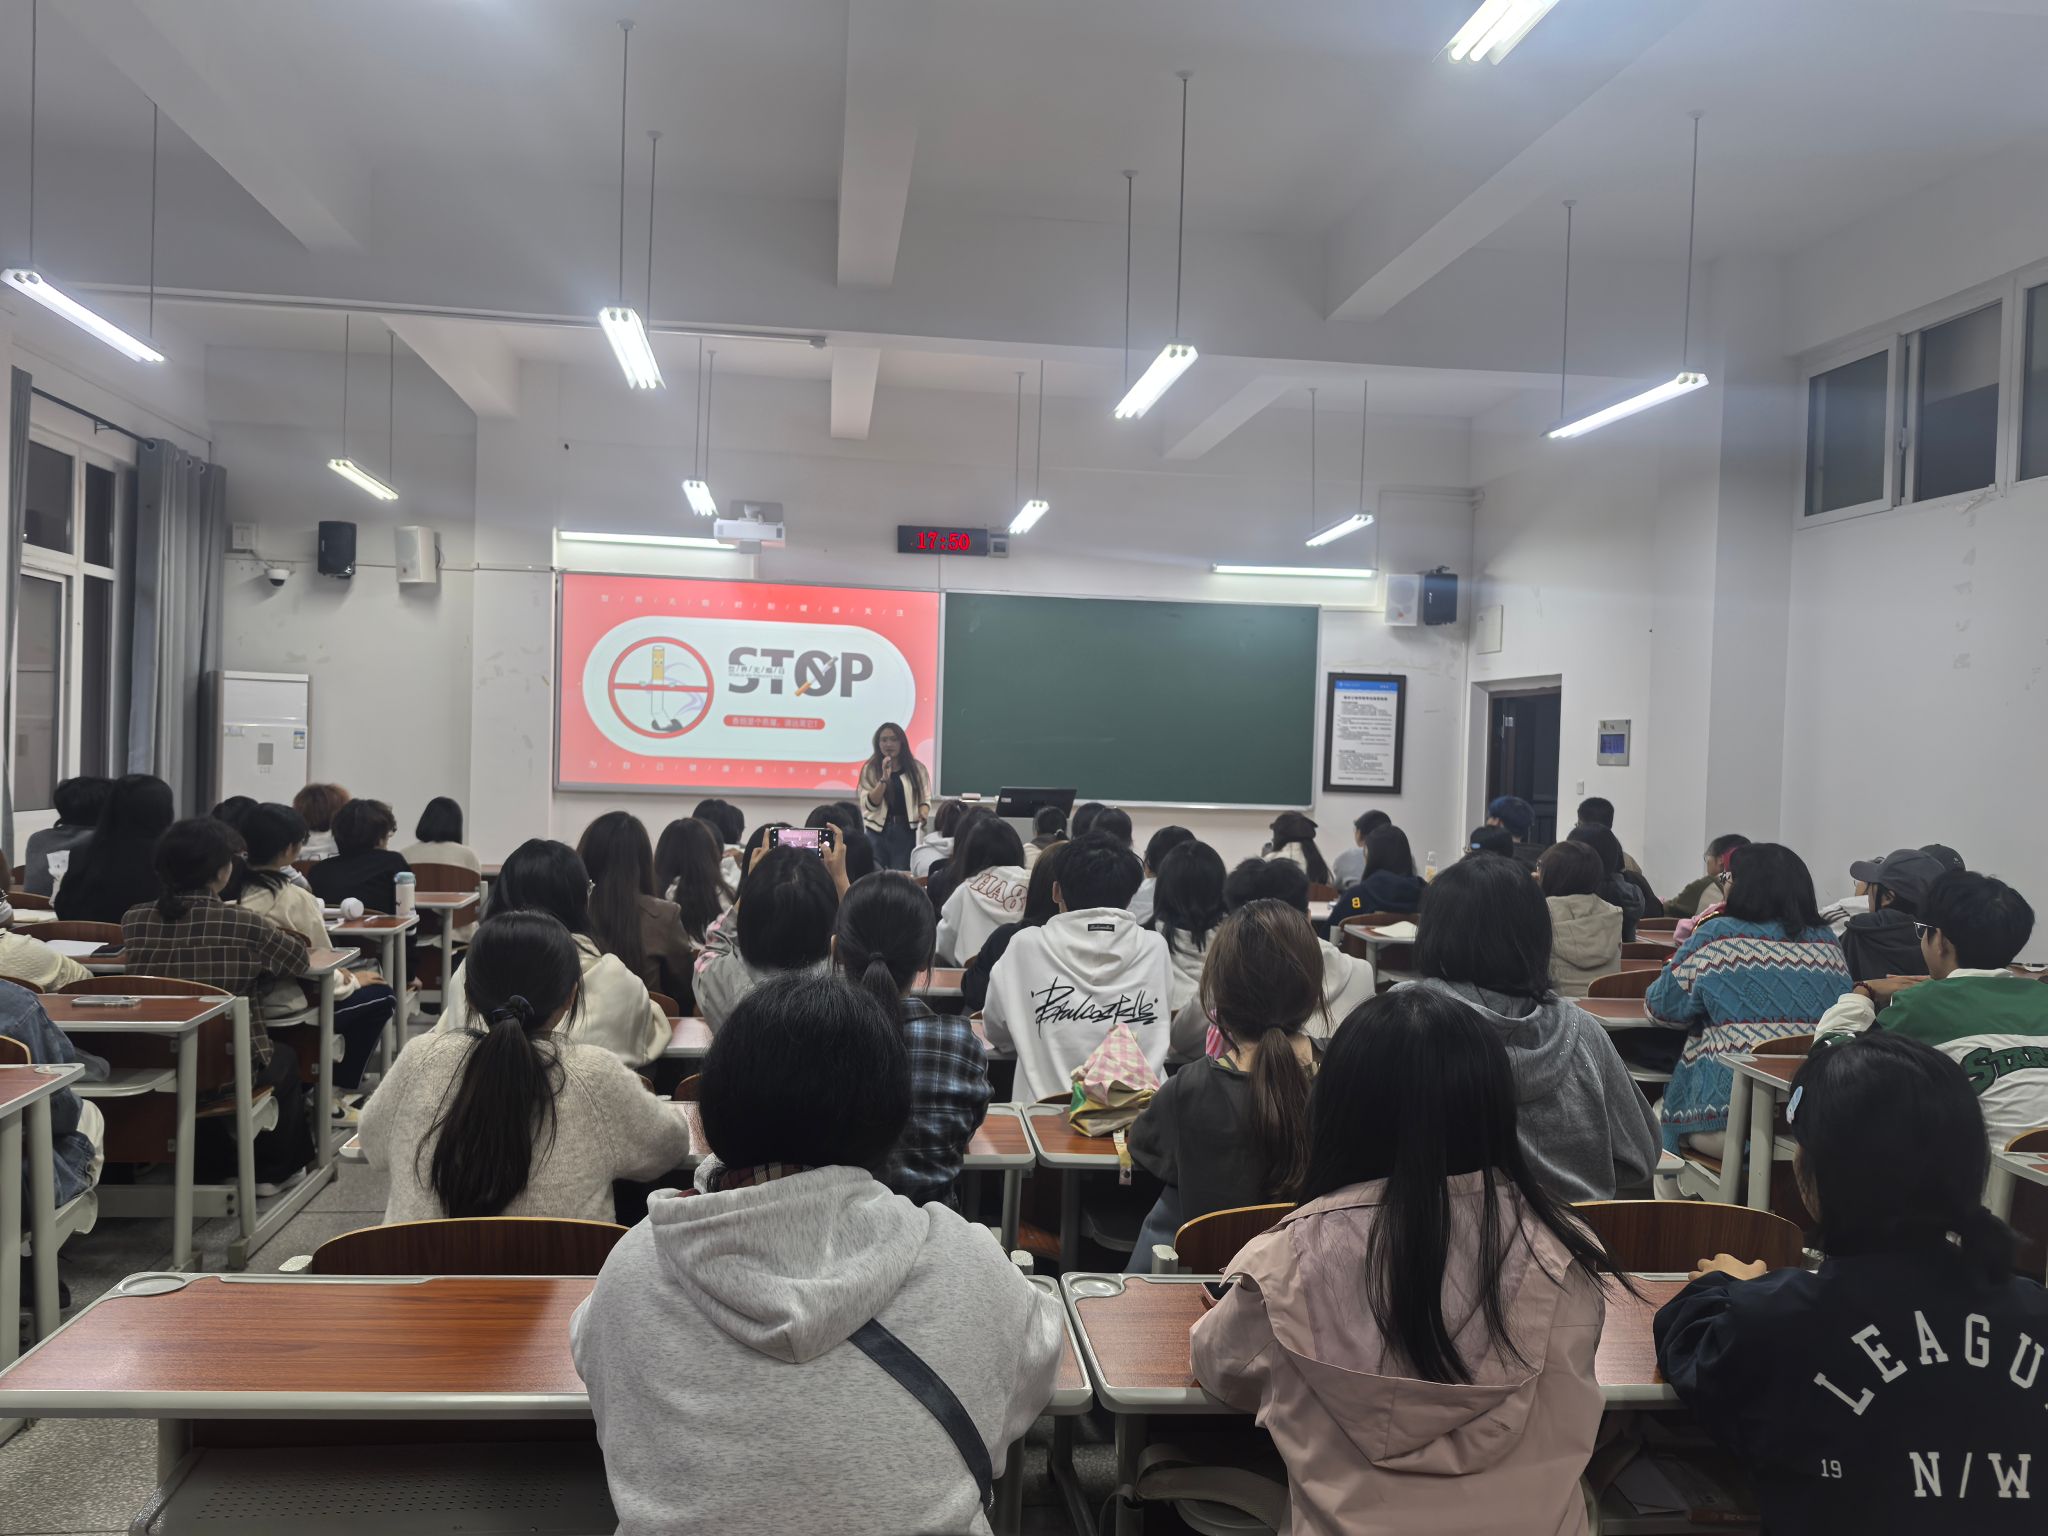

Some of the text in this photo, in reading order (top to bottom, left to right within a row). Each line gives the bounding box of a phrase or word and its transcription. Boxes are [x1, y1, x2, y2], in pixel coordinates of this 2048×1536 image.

[916, 531, 971, 551] 17:50
[728, 646, 874, 698] STOP
[1813, 1310, 2048, 1417] LEAGU
[1820, 1458, 1843, 1479] 19
